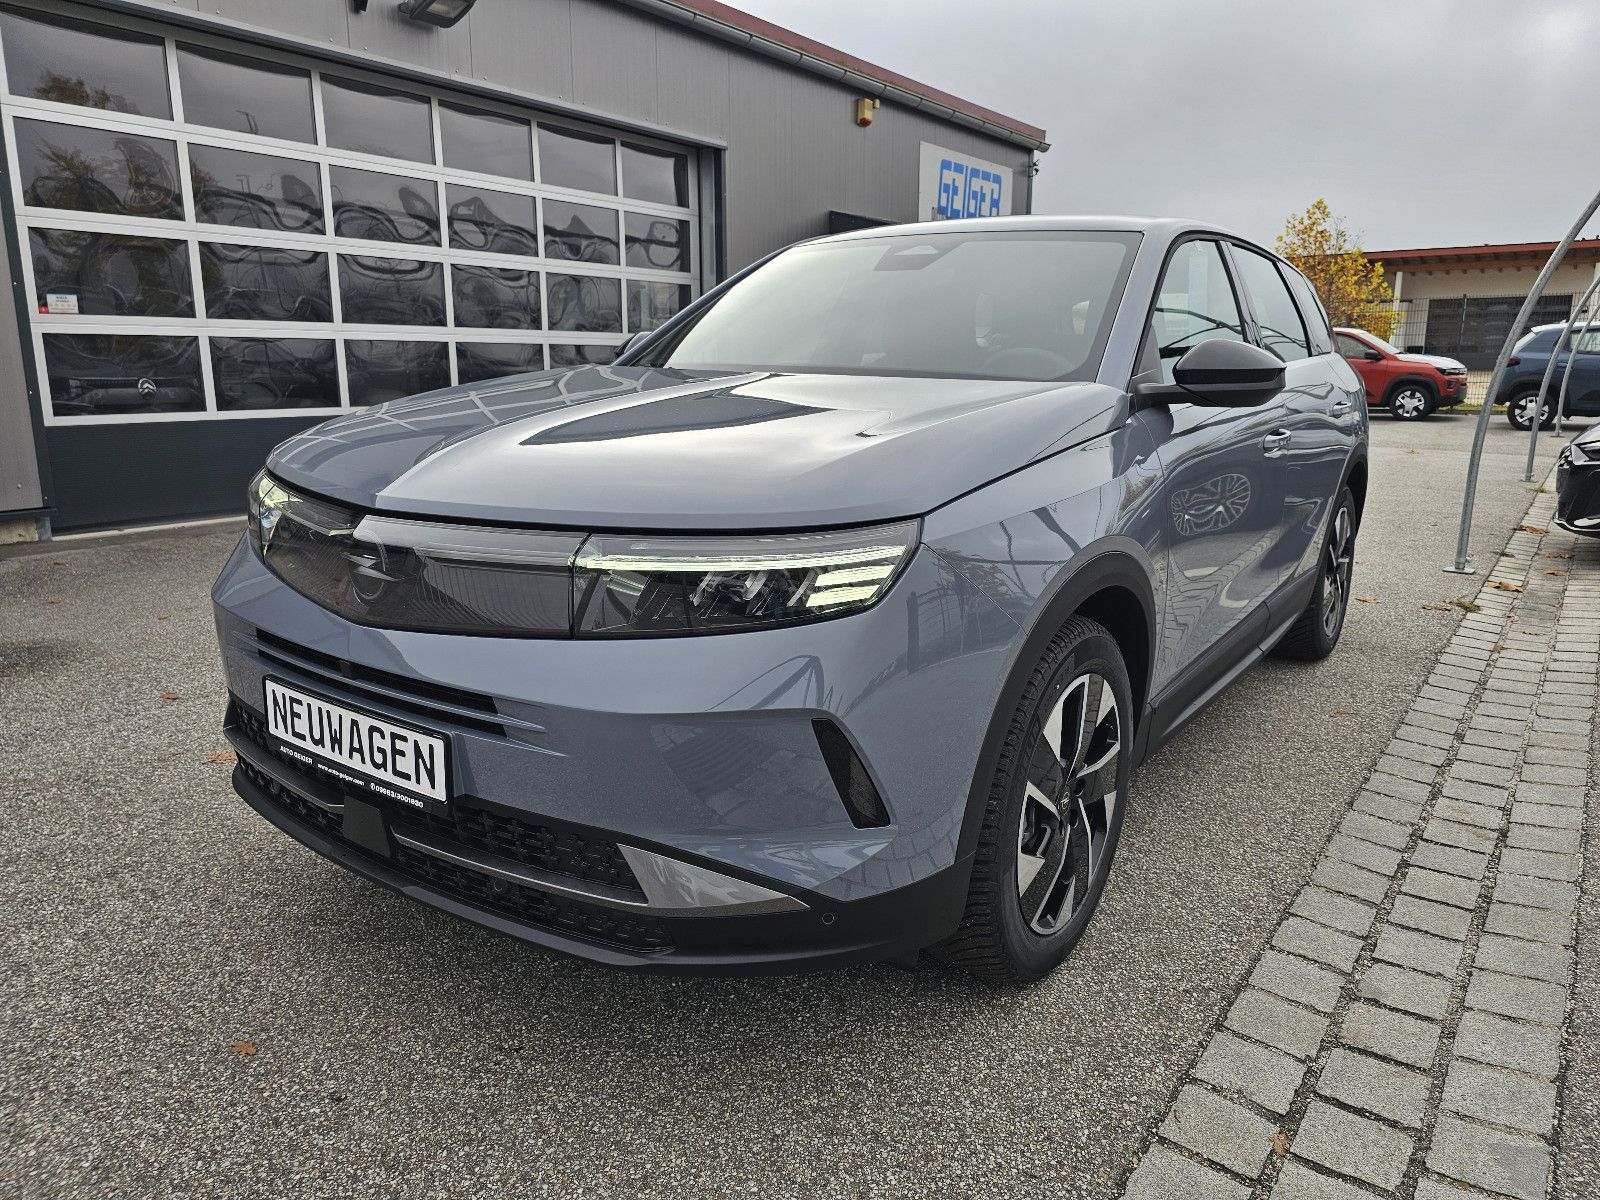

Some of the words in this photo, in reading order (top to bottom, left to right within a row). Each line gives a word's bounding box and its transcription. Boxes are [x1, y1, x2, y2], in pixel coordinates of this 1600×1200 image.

[937, 158, 1002, 219] GEIGER
[271, 688, 436, 790] NEUWAGEN
[279, 745, 294, 756] AUTO
[293, 751, 313, 765] GEIGER
